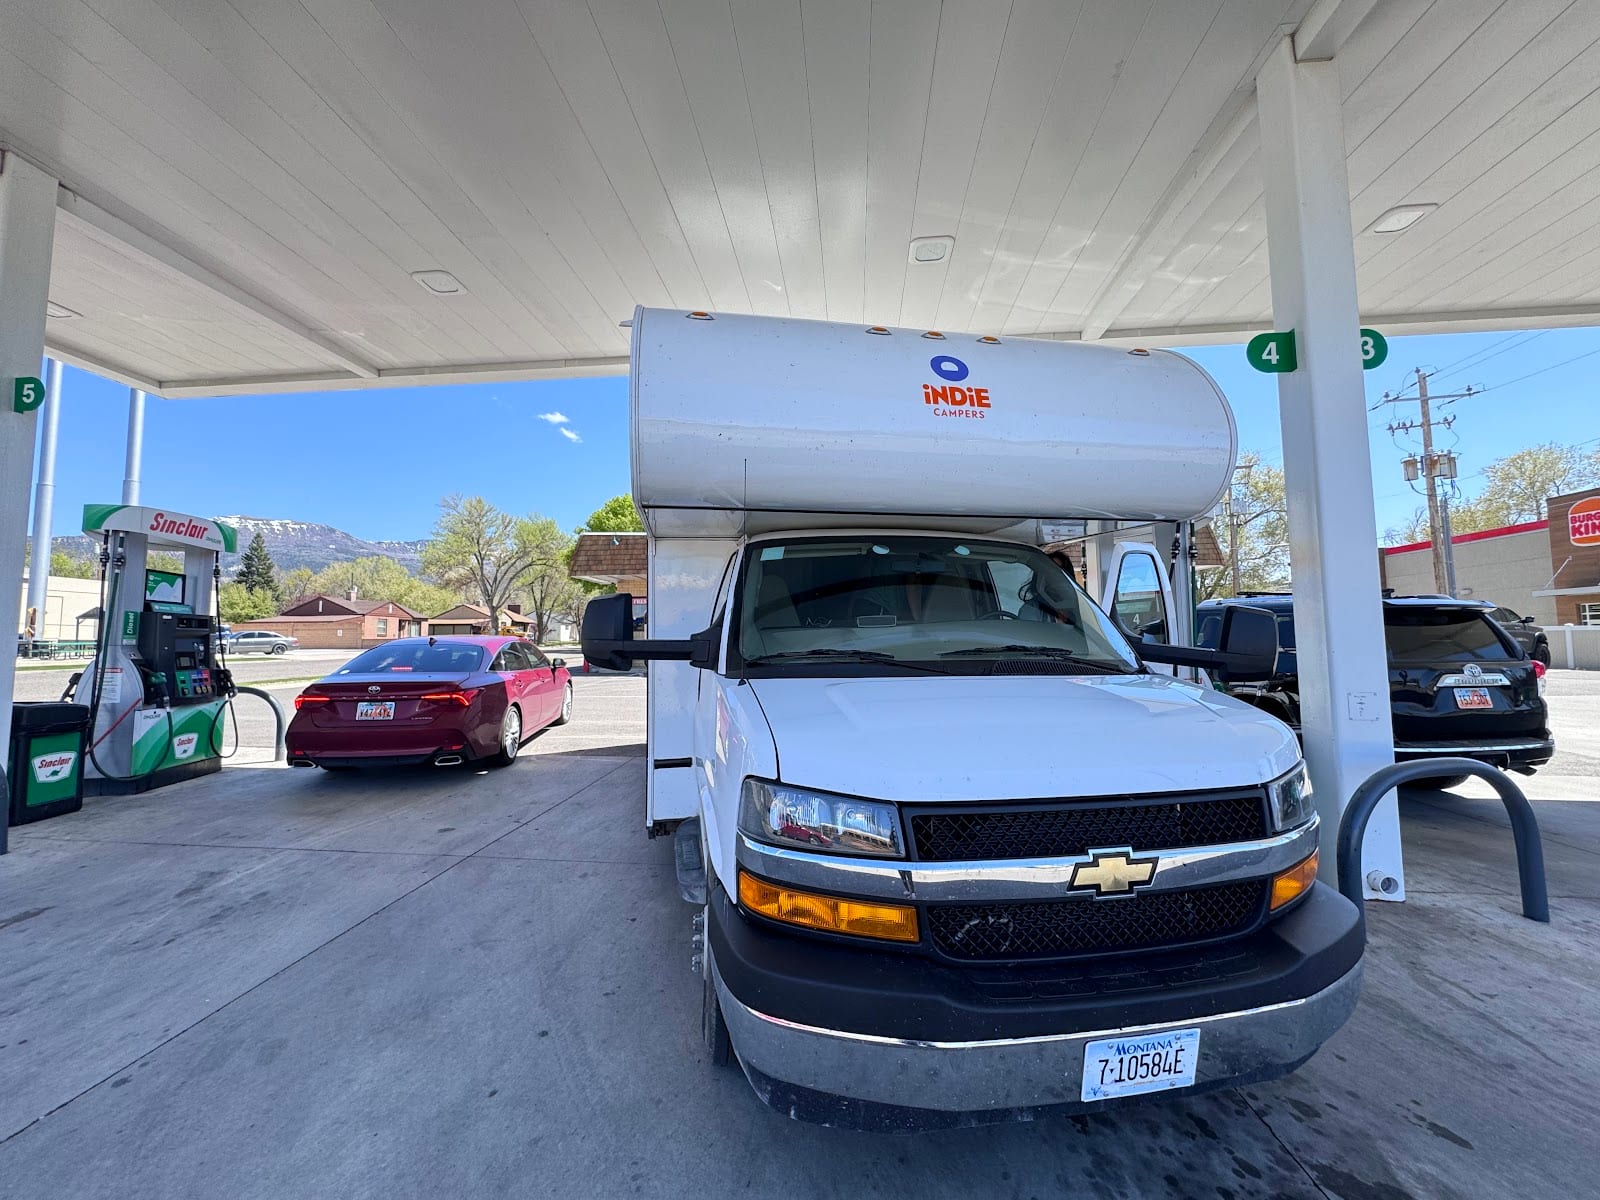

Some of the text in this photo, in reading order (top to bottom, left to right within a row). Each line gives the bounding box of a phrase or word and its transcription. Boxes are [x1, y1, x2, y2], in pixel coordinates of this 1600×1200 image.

[1261, 341, 1280, 365] 4
[1361, 336, 1376, 360] 3
[22, 383, 35, 404] 5
[933, 407, 985, 419] CAMPERS
[149, 512, 208, 540] Sinclair
[126, 612, 135, 634] Diesel
[1132, 613, 1141, 625] 4
[38, 756, 72, 769] Sinclair
